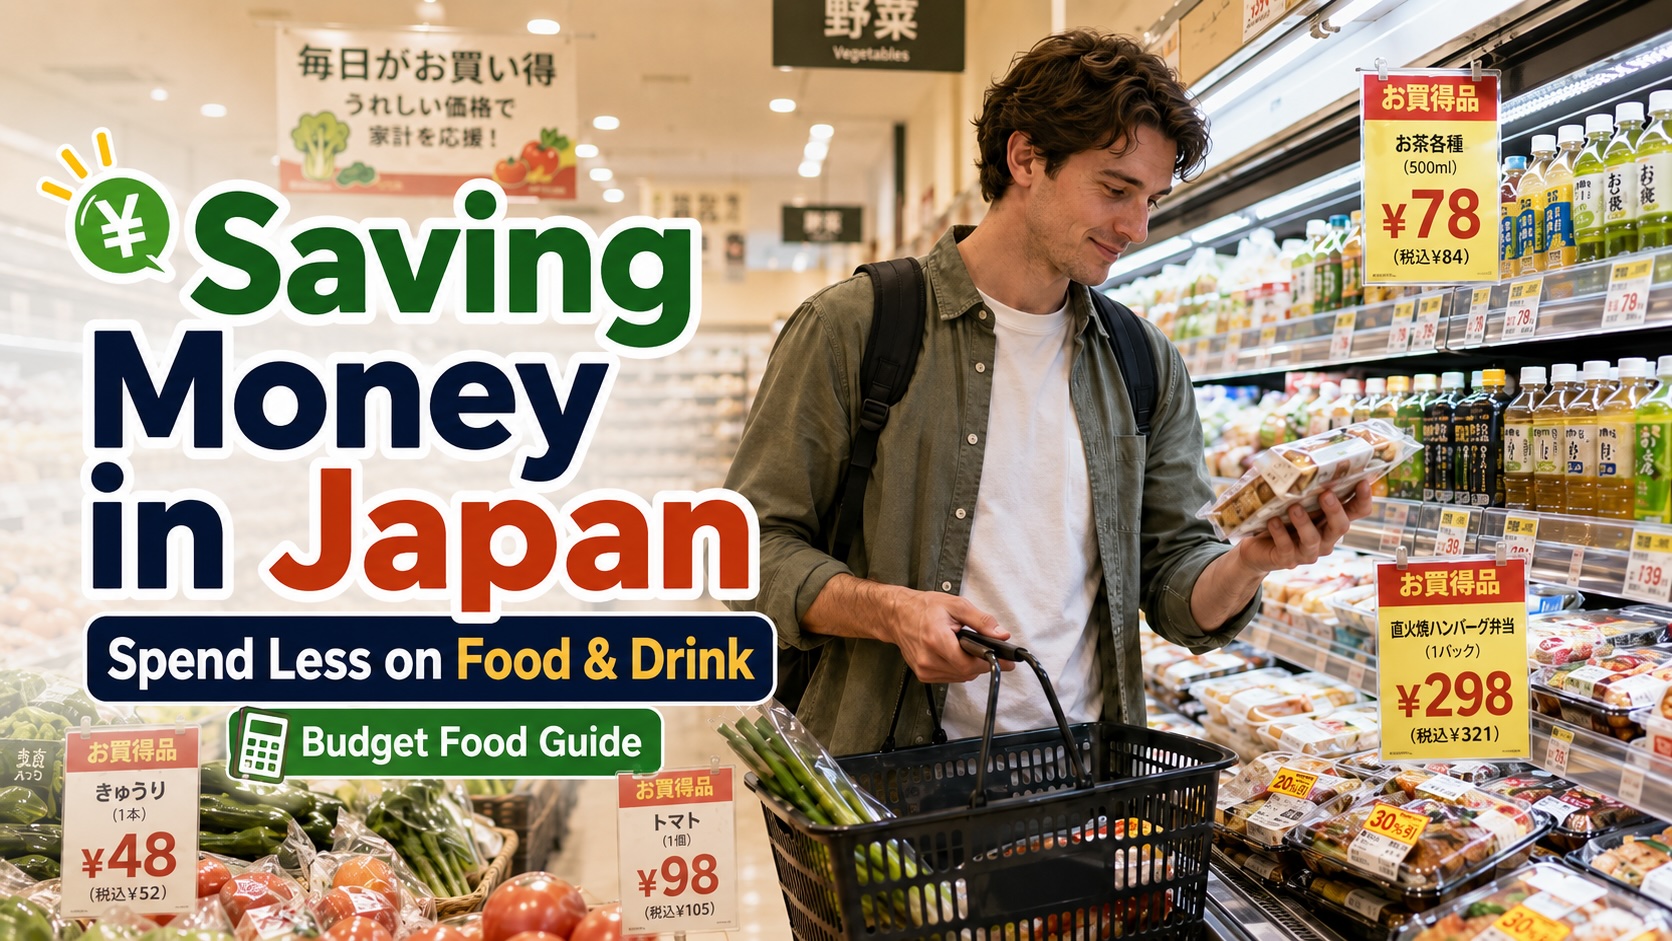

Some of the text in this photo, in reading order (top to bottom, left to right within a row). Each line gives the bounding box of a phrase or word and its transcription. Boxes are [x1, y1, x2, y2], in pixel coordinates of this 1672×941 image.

[824, 0, 918, 41] 野菜
[832, 45, 910, 62] Vegetables
[298, 44, 557, 86] 毎日がお買い得
[345, 93, 516, 118] うれしい価格で
[1381, 83, 1480, 113] お買得品
[1395, 134, 1464, 154] お茶各種
[1403, 160, 1458, 175] (500ml)
[1382, 188, 1481, 240] ¥78
[1393, 248, 1470, 265] (税込¥84)
[1400, 569, 1500, 597] お買得品
[1396, 671, 1513, 718] ¥298
[1410, 725, 1500, 744] (税込¥321)
[88, 738, 177, 764] お買得品
[96, 781, 166, 801] きゅうり
[636, 776, 713, 800] お買得品
[112, 807, 147, 822] (1本)
[654, 812, 700, 831] トマト
[662, 834, 691, 848] (1個)
[81, 831, 177, 878] ¥48
[636, 853, 719, 898] ¥98
[89, 885, 168, 902] (税込¥52)
[644, 901, 715, 921] (税込¥105)
